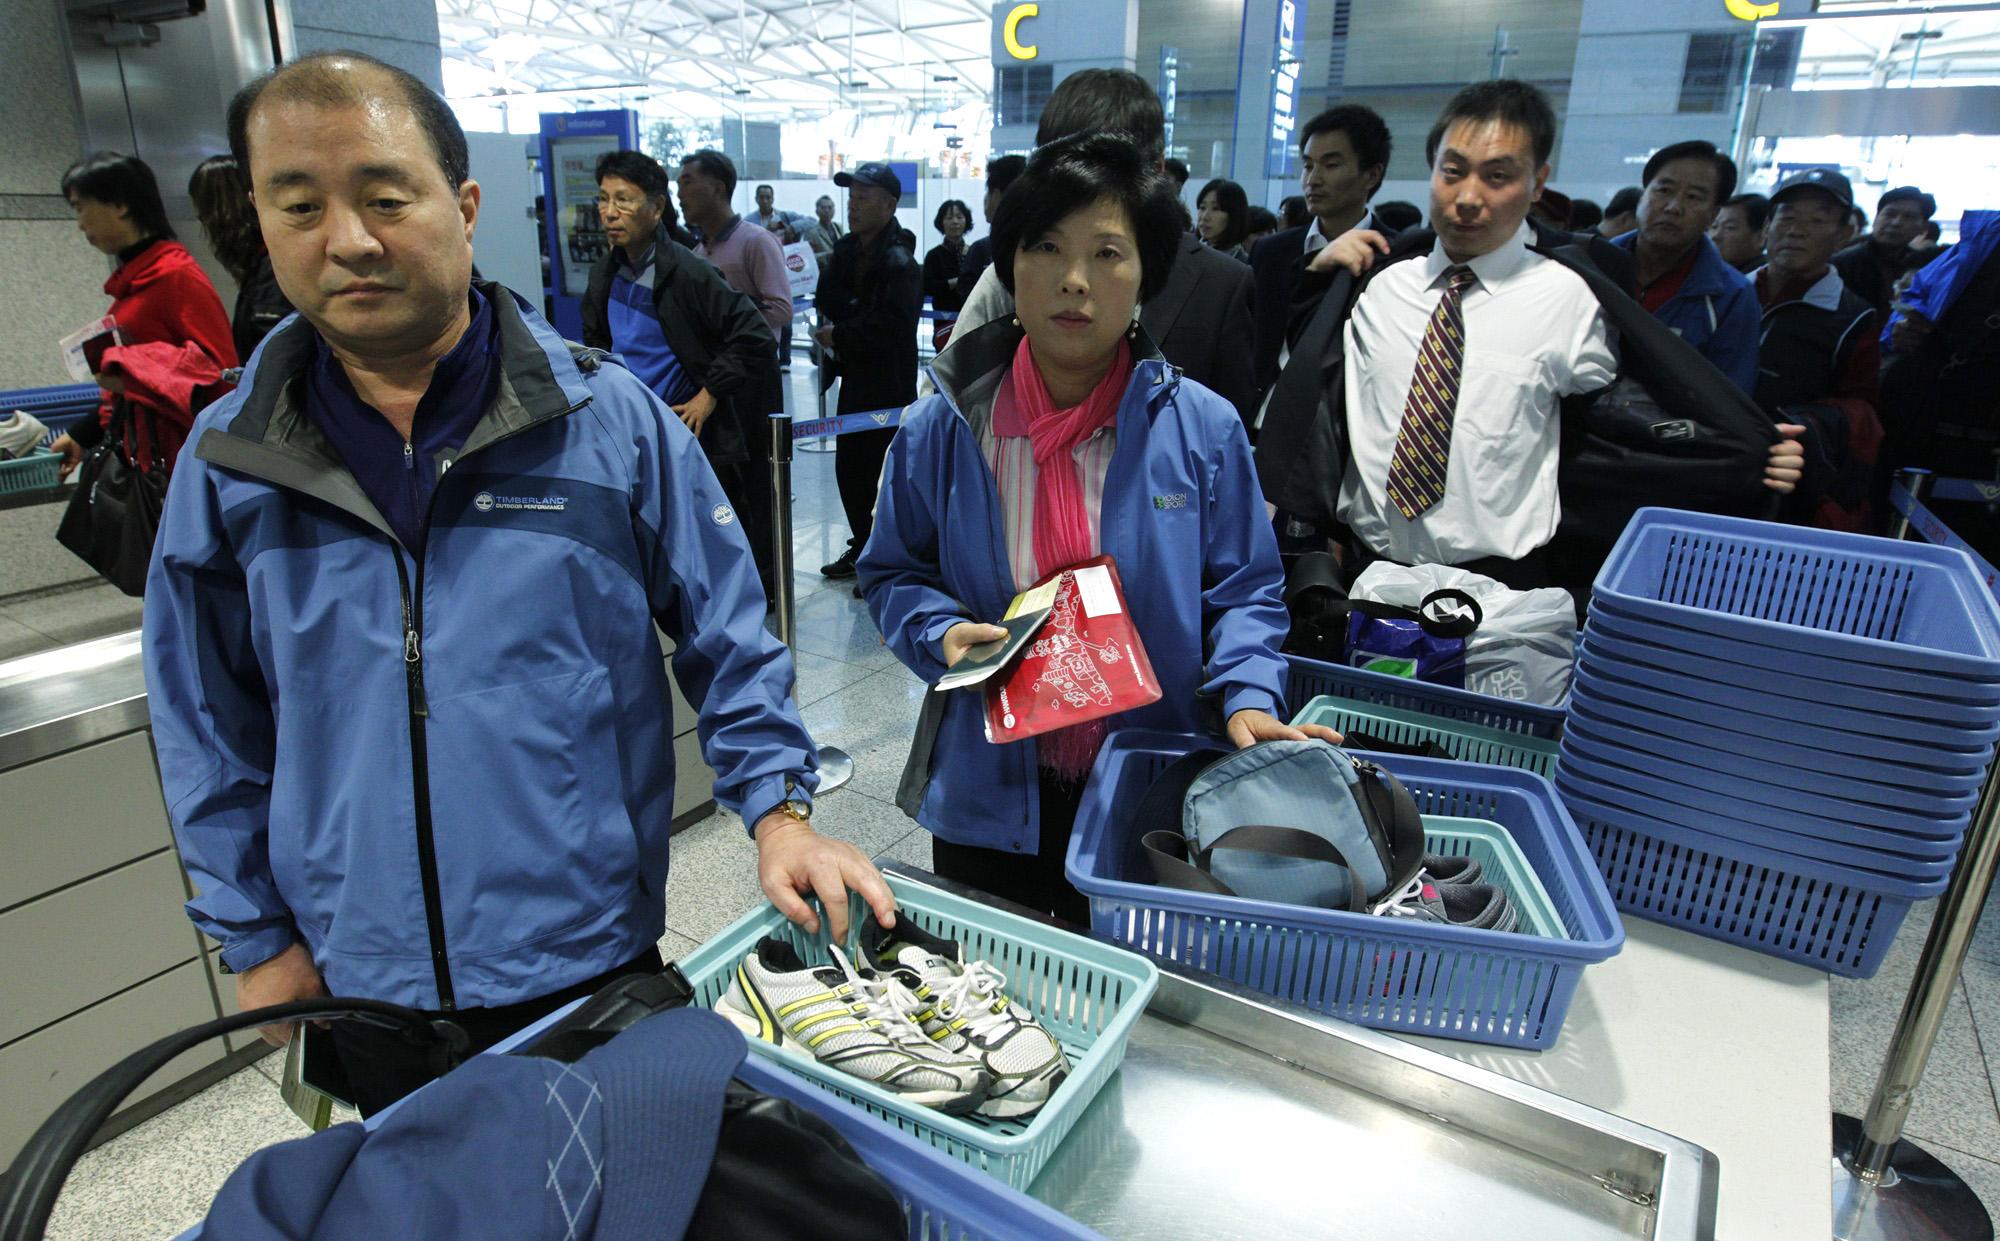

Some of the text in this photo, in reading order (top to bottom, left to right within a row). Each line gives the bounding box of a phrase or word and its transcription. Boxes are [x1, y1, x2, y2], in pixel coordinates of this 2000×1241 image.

[1003, 3, 1038, 60] C
[793, 418, 843, 438] SECURITY
[1164, 493, 1186, 501] KOLON
